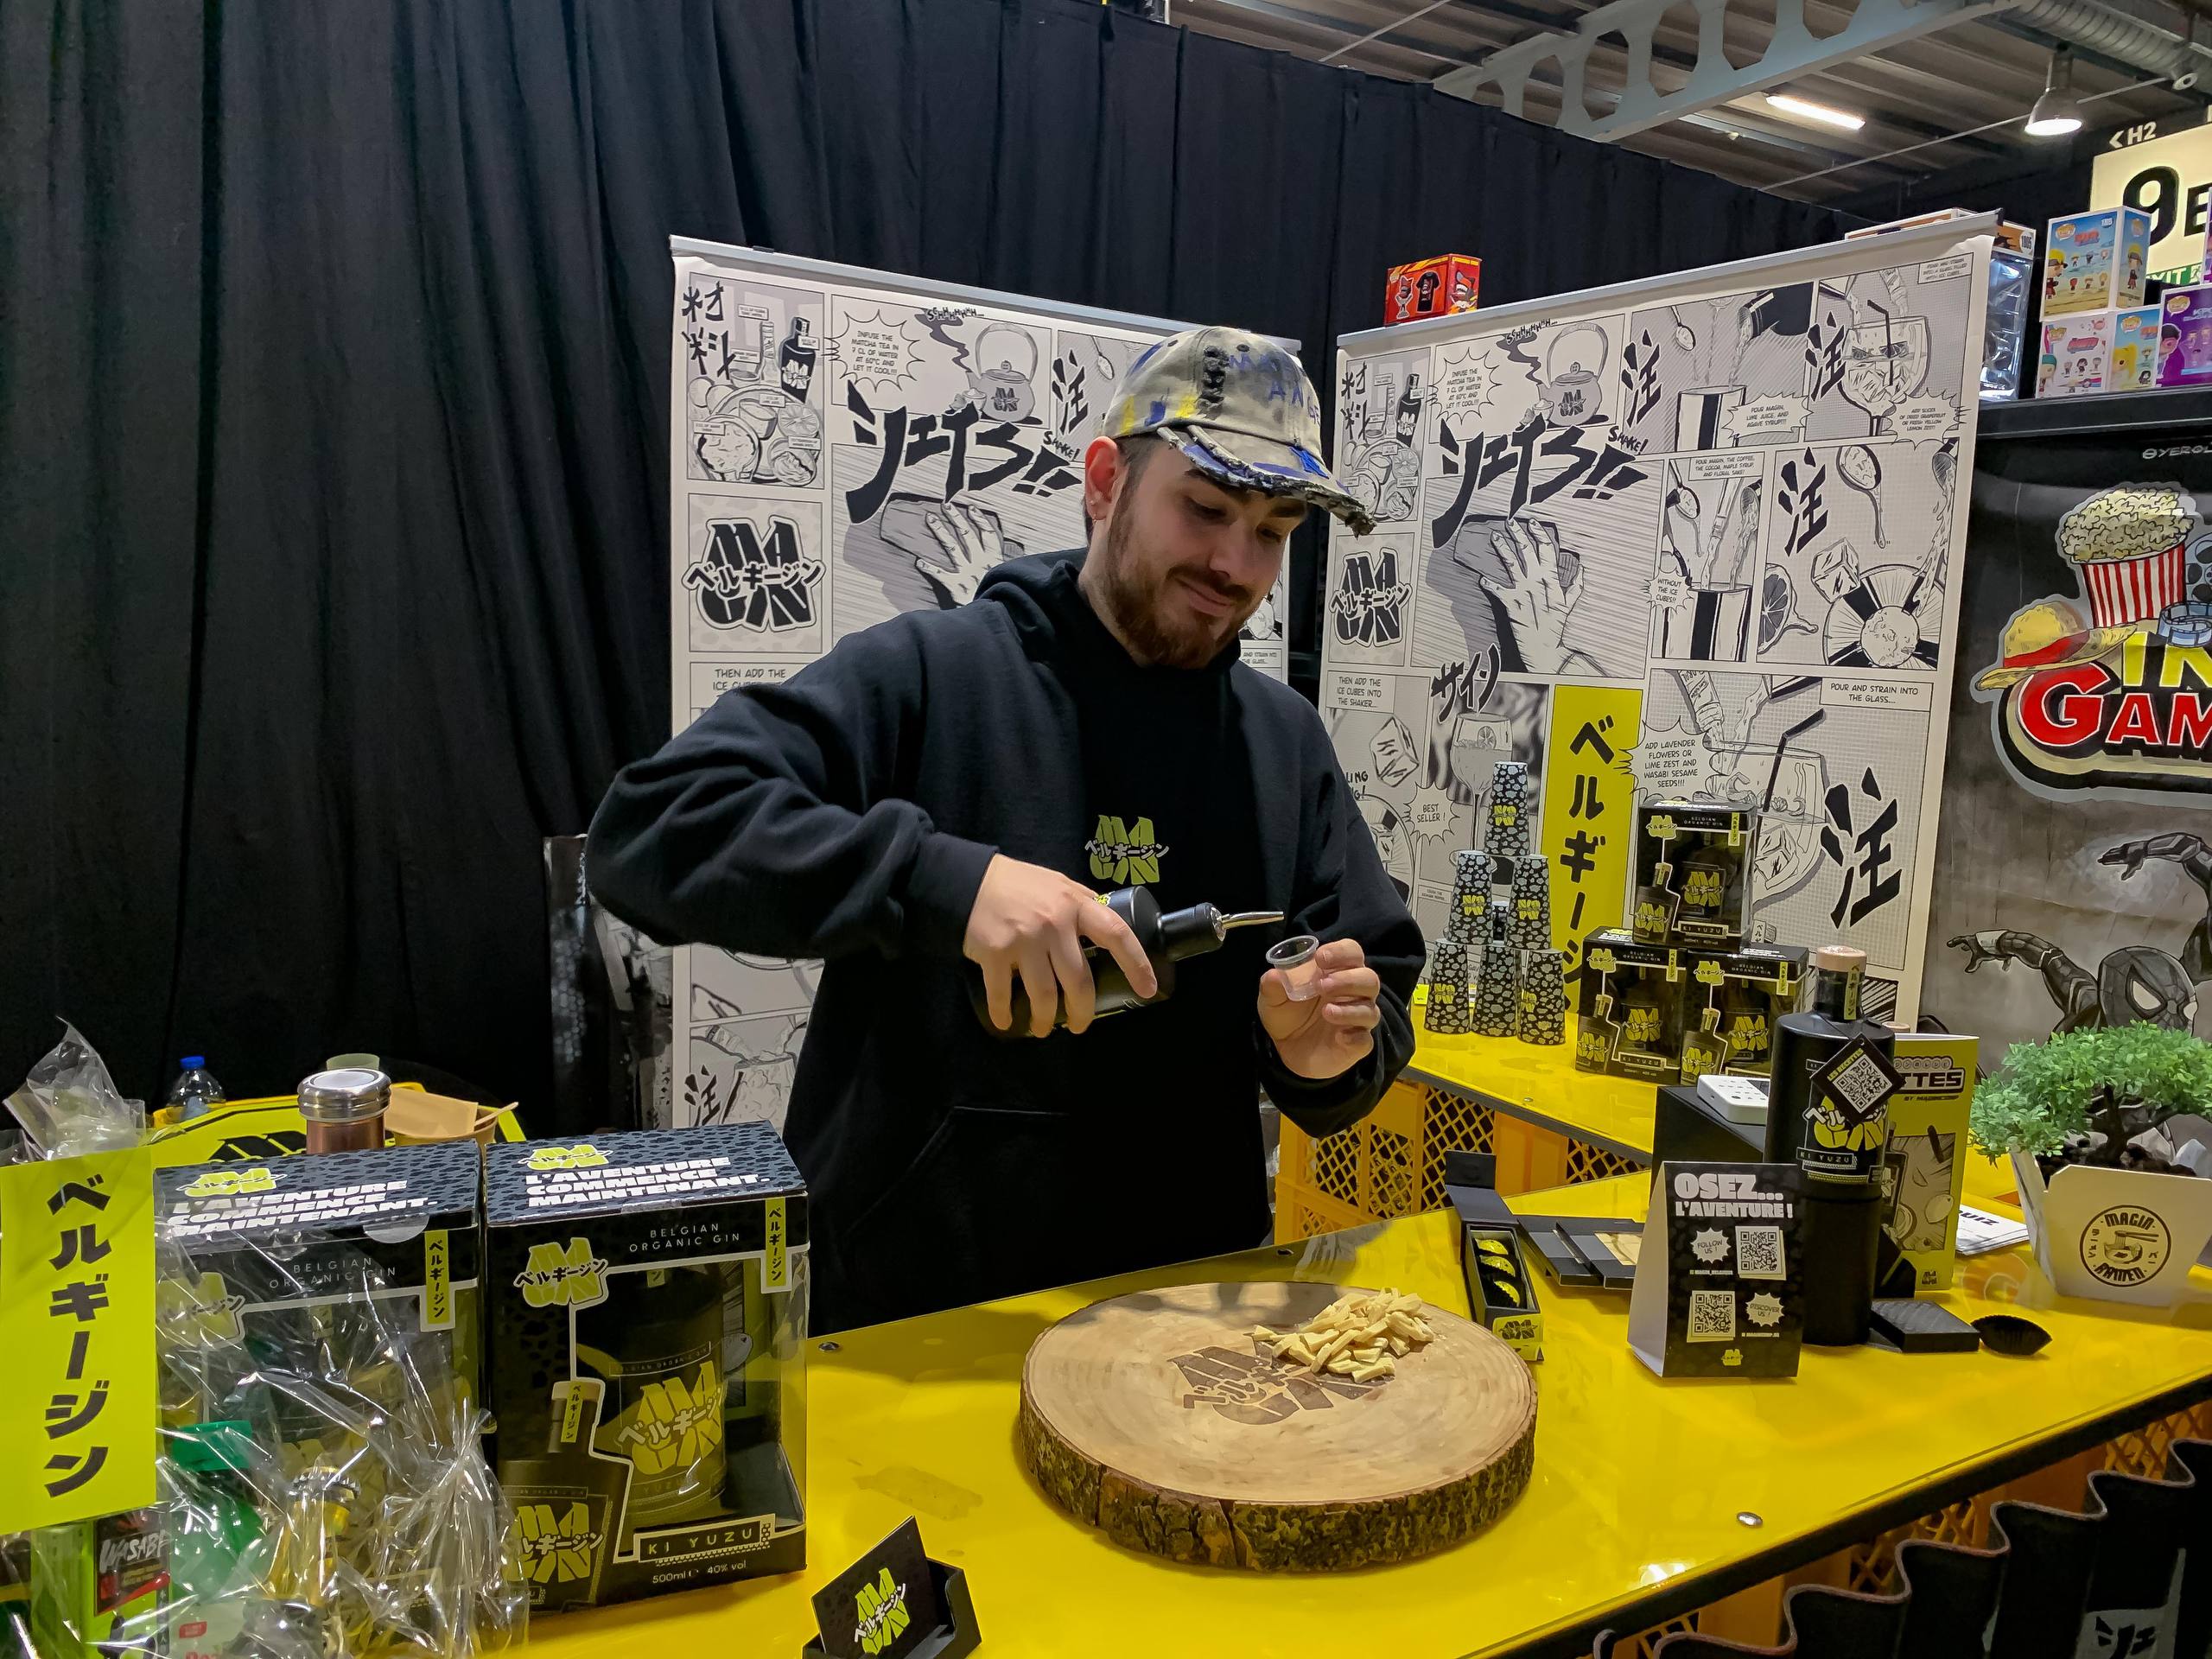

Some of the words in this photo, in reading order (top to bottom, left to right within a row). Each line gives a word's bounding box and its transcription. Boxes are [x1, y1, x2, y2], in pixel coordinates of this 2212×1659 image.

[2127, 121, 2157, 145] H2
[851, 338, 877, 347] MATCHA
[879, 340, 890, 349] TEA
[857, 331, 880, 340] INFUSE
[881, 334, 893, 342] THE
[1452, 369, 1468, 378] INFUSE
[1042, 430, 1079, 460] SHAKE!
[1608, 426, 1649, 454] SHAKE!
[1778, 446, 1828, 557] 注
[686, 563, 821, 590] ベルギージン
[1657, 577, 1681, 588] WITHOUT
[1331, 586, 1410, 613] ベルギージン
[715, 668, 741, 678] THEN
[745, 668, 764, 678] ADD
[768, 668, 786, 678] THE
[1338, 676, 1353, 685] THEN
[1354, 677, 1367, 686] ADD
[1369, 678, 1382, 687] THE
[713, 681, 728, 691] ICE
[1337, 686, 1345, 695] ICE
[1346, 687, 1365, 696] CUBES
[1367, 689, 1382, 698] INTO
[1831, 683, 1851, 692] POUR
[1852, 683, 1869, 693] AND
[1870, 685, 1897, 695] STRAIN
[1900, 686, 1918, 696] INTO
[1849, 693, 1864, 702] THE
[1645, 741, 1658, 750] ADD
[1661, 739, 1696, 749] LAVENDER
[1649, 750, 1680, 760] FLOWERS
[1682, 749, 1692, 758] OR
[1644, 770, 1669, 779] WASABI
[1672, 768, 1698, 777] SESAME
[1645, 761, 1661, 770] LIME
[1682, 759, 1697, 767] AND
[1422, 803, 1440, 813] BEST
[1416, 814, 1440, 823] SELLER
[1084, 839, 1170, 861] ベルギージン
[1820, 766, 1904, 930] 注
[1800, 1151, 1811, 1160] KI
[1819, 1154, 1850, 1163] YUZU
[525, 1156, 732, 1185] L'AVENTURE
[526, 1167, 718, 1196] COMMENCE
[528, 1173, 772, 1208] MAINTENANT.
[172, 1179, 408, 1214] L'AVENTURE
[168, 1192, 388, 1224] COMMENCE
[1675, 1201, 1784, 1218] L'AVENTURE
[1787, 1203, 1794, 1219] !
[650, 1223, 720, 1239] BELGIAN
[2104, 1212, 2155, 1230] MAGIN
[629, 1235, 702, 1253] ORGANIC
[713, 1231, 741, 1243] GIN
[768, 1207, 783, 1282] ベルギージン
[1696, 1239, 1723, 1249] FOLLOW
[293, 1257, 372, 1274] BELGIAN
[515, 1259, 608, 1287] ベルギージン
[2093, 1262, 2146, 1282] RAMEN
[269, 1271, 353, 1289] ORGANIC
[366, 1266, 397, 1279] GIN
[429, 1240, 446, 1319] ベルギージン
[1749, 1303, 1781, 1313] DISCOVER
[43, 1173, 113, 1499] ベルギージン
[565, 1384, 582, 1440] ベルギージン
[648, 1541, 670, 1555] KI
[689, 1528, 753, 1548] YUZU
[652, 1570, 686, 1584] 500ml
[707, 1564, 728, 1575] 40%
[730, 1559, 747, 1571] vol
[854, 1582, 906, 1643] ベルギージン
